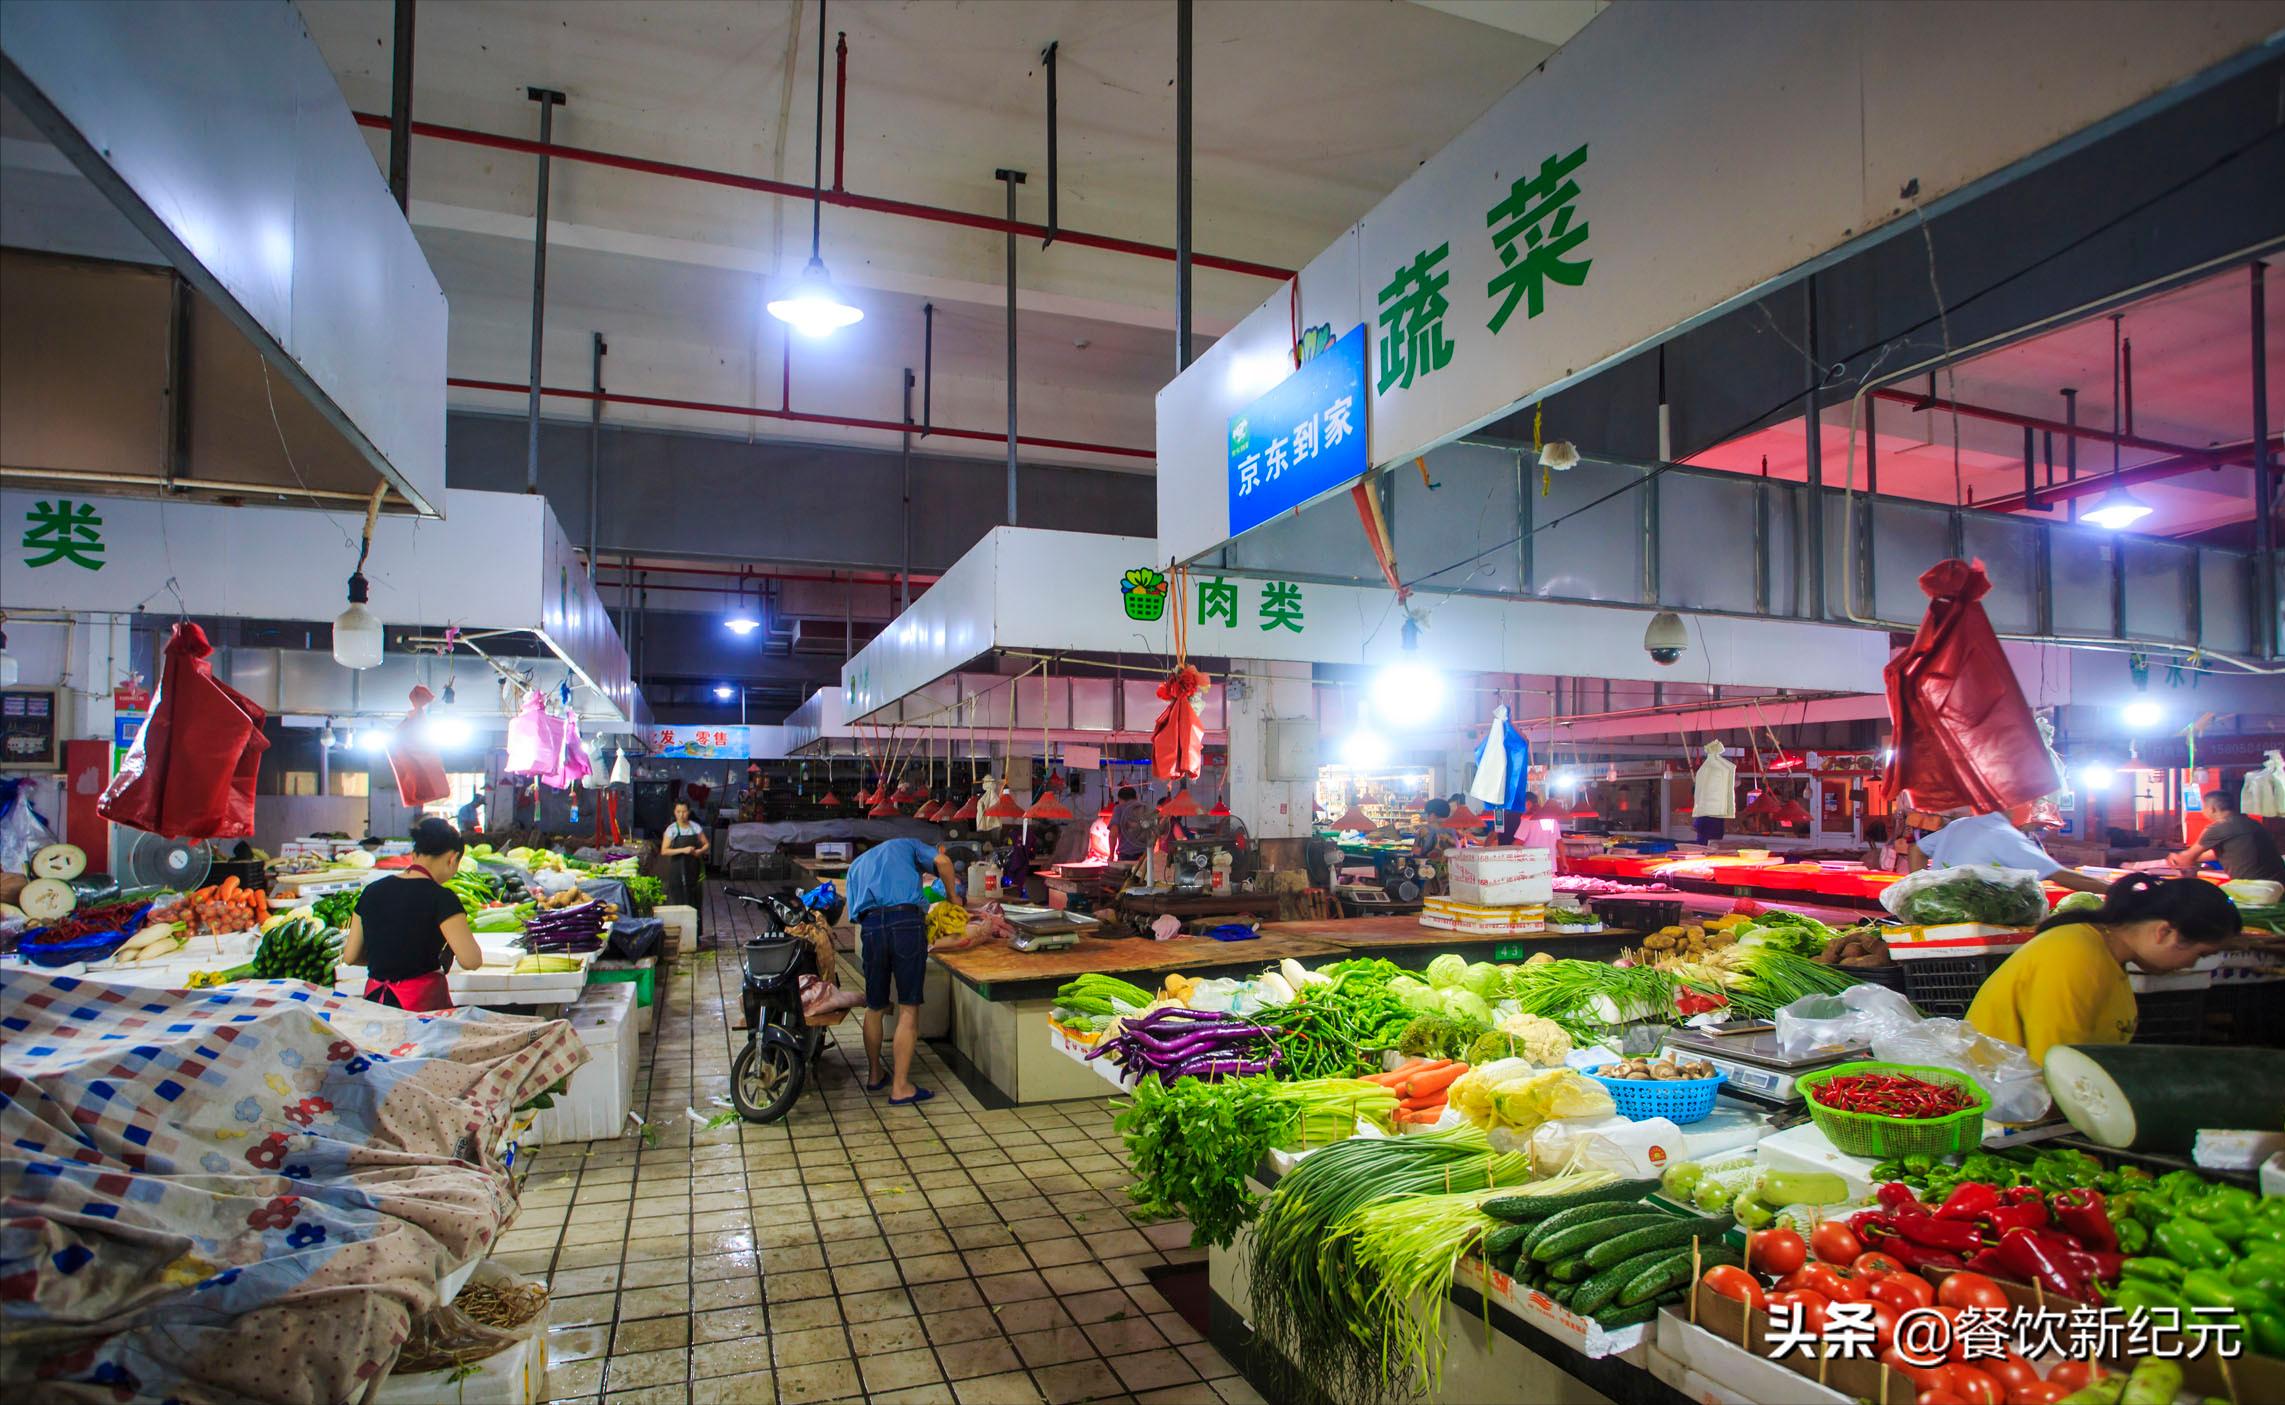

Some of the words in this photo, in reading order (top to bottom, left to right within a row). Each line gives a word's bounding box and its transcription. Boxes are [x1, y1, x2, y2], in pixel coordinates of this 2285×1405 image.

[1377, 143, 1593, 397] 蔬菜
[1237, 395, 1353, 497] 京东到家
[22, 499, 106, 571] 类
[1197, 575, 1305, 634] 肉类
